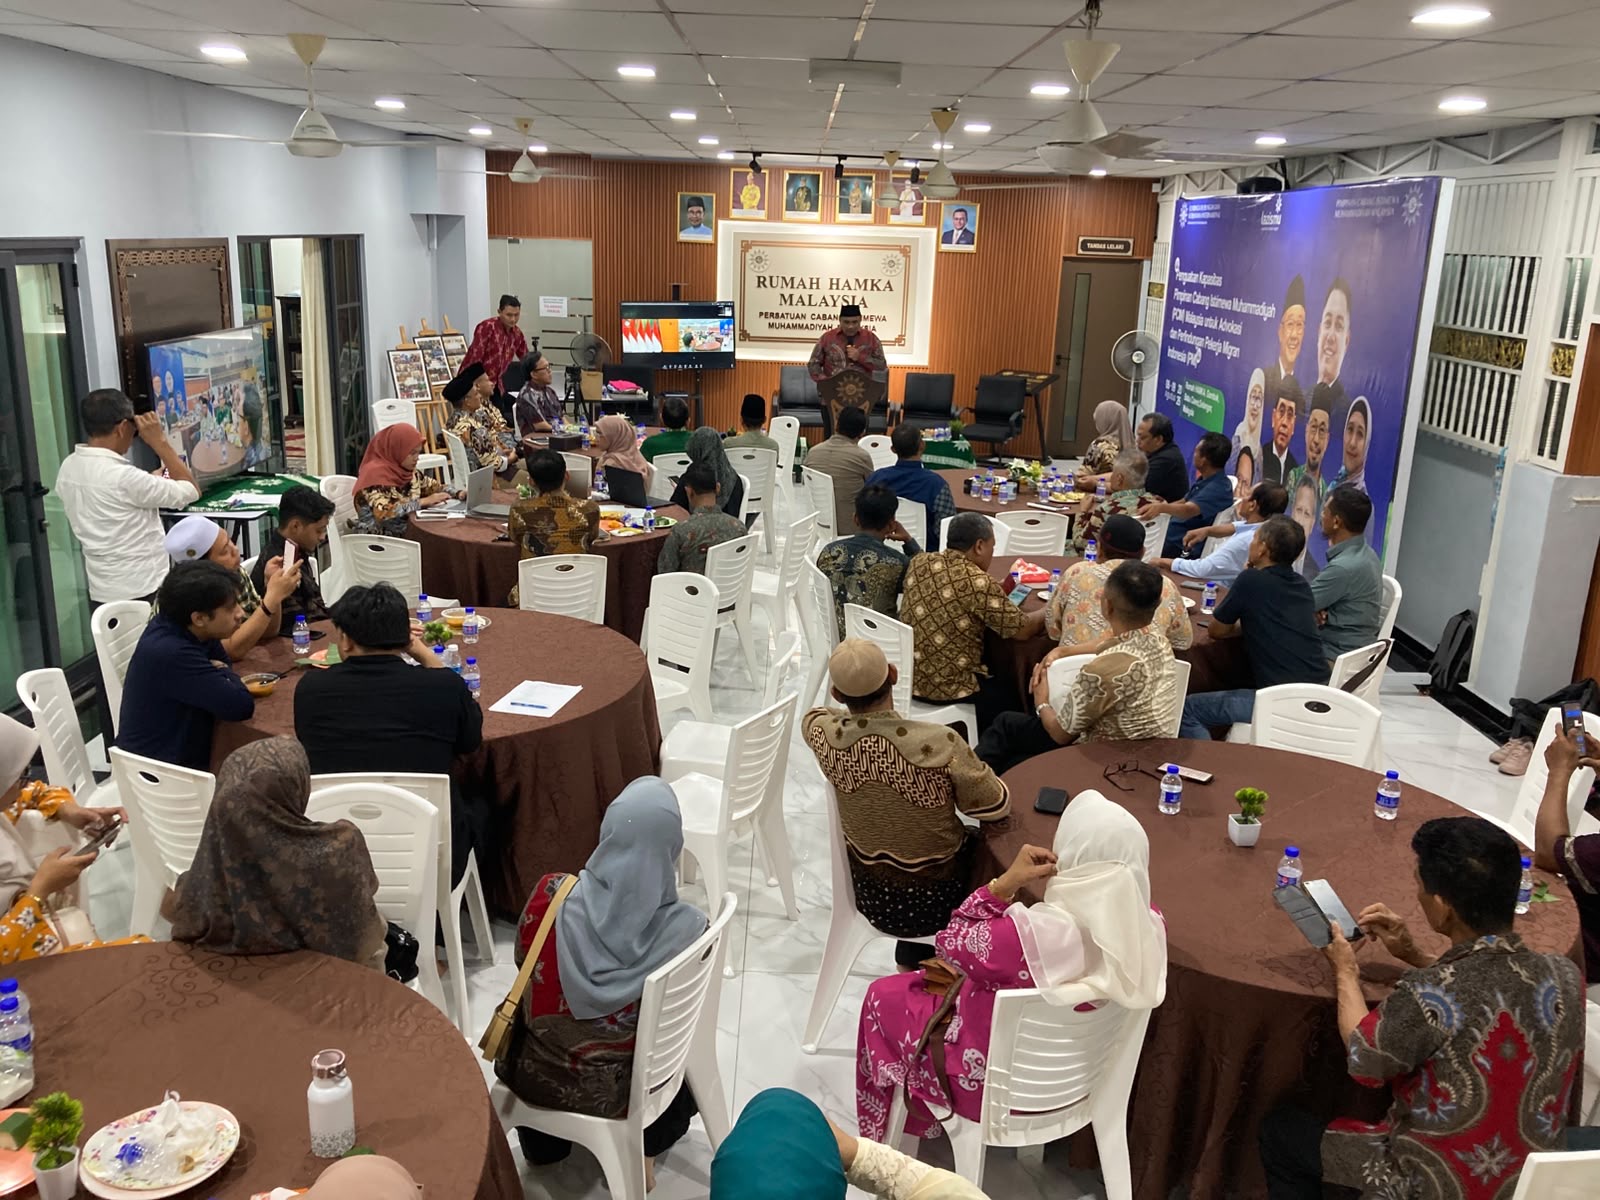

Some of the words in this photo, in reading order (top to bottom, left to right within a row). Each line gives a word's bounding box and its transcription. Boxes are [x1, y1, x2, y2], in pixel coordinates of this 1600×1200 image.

[756, 275, 820, 290] RUMAH
[828, 277, 894, 292] HAMKA
[779, 293, 869, 309] MALAYSIA
[1232, 297, 1277, 322] Muhammadiyah
[758, 311, 807, 321] PERSATUAN
[810, 313, 839, 322] CABAN
[768, 322, 833, 331] MUHAMMADIYAH
[1204, 316, 1219, 330] untuk
[1219, 318, 1243, 336] Advokasi
[1222, 340, 1240, 360] Migran
